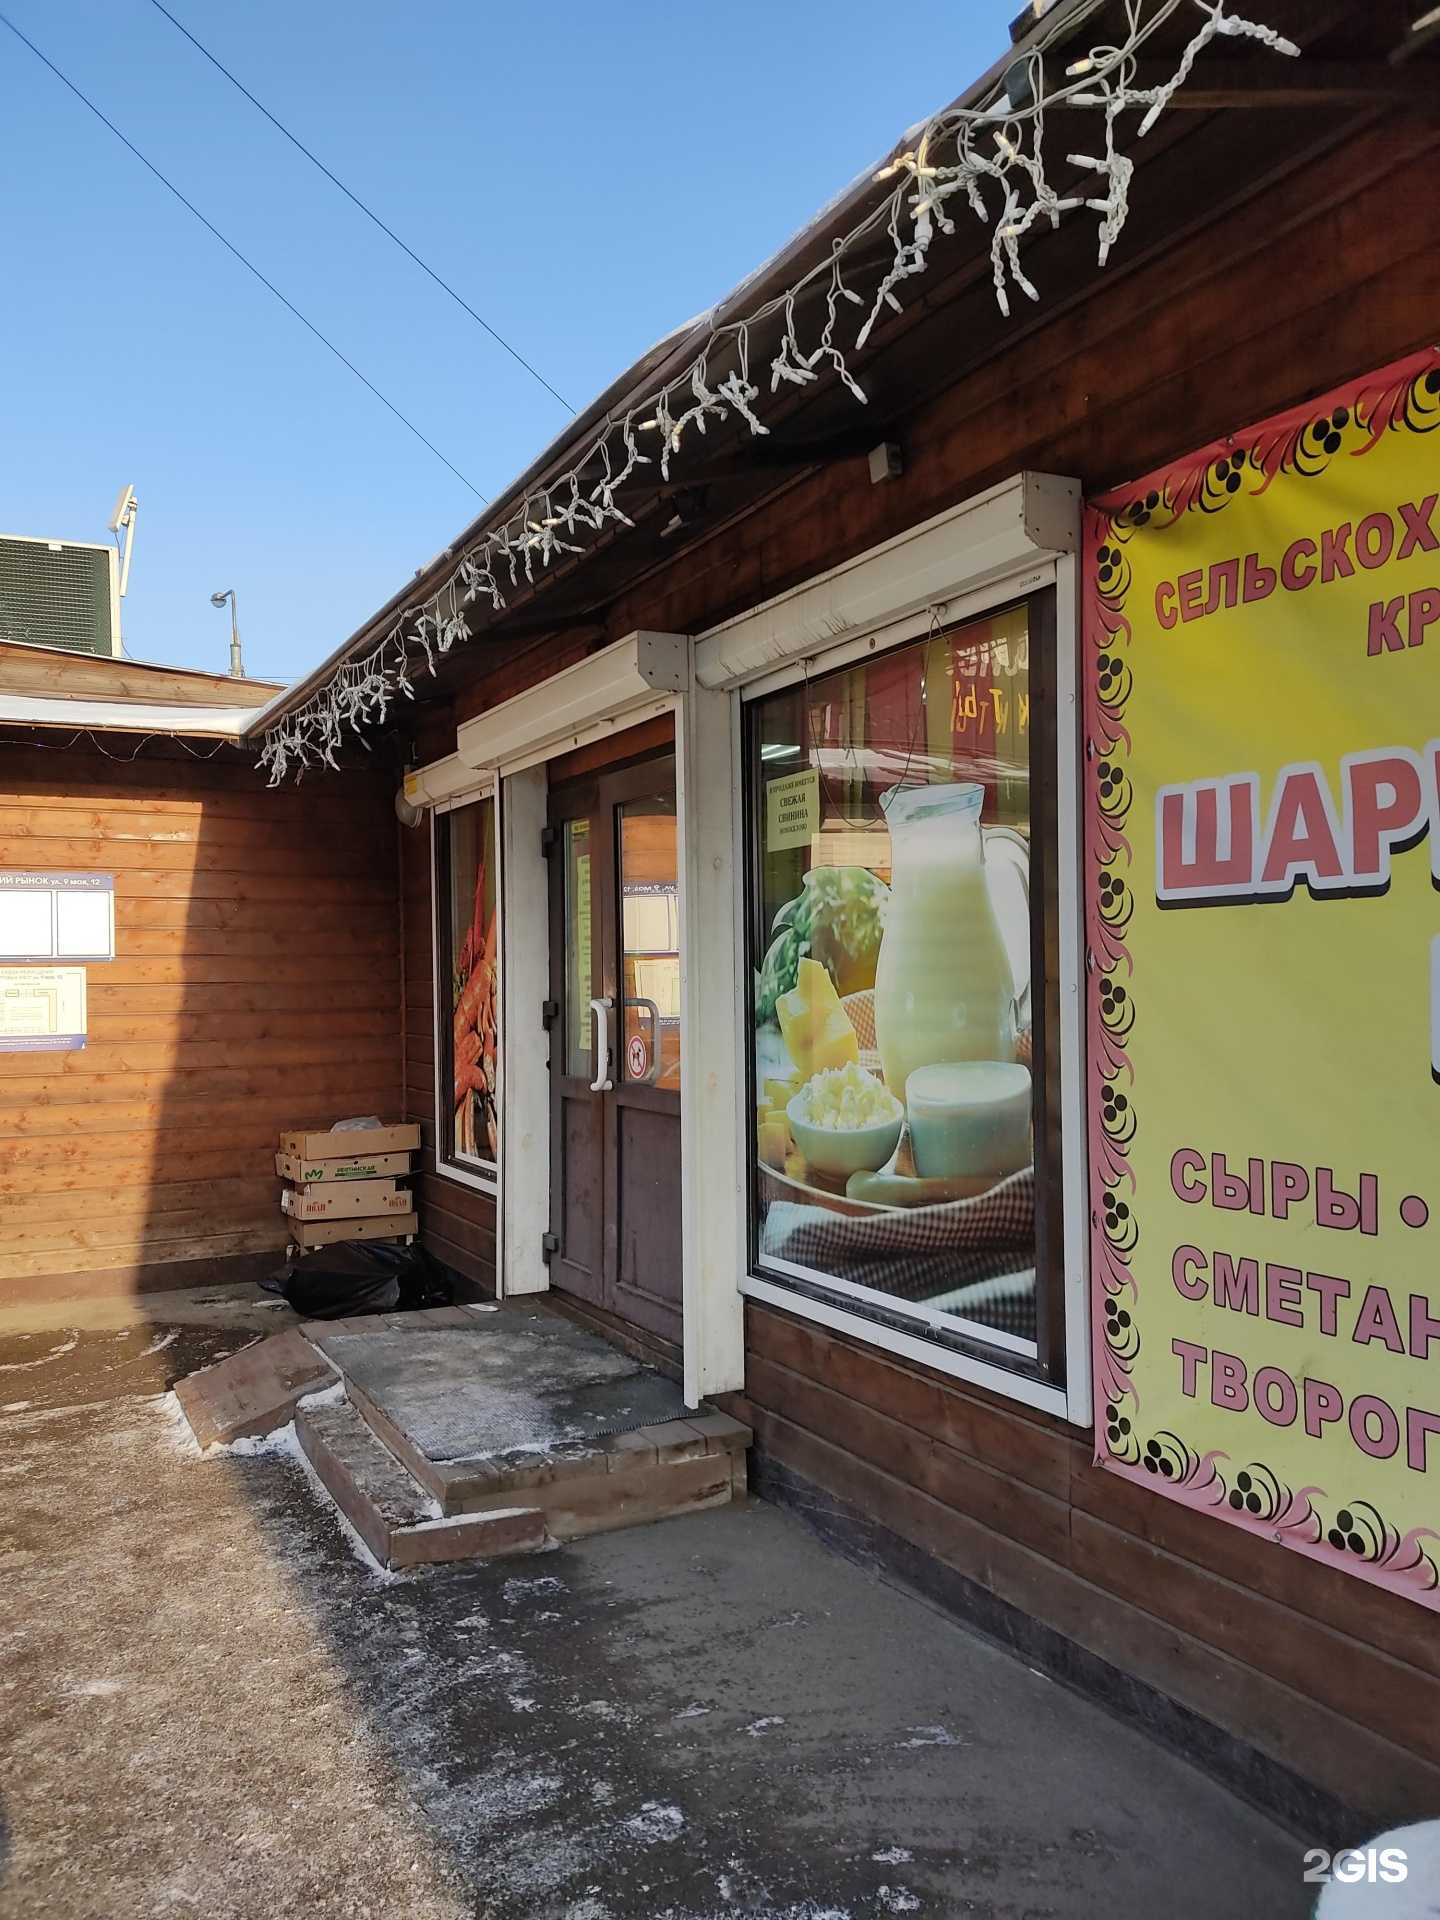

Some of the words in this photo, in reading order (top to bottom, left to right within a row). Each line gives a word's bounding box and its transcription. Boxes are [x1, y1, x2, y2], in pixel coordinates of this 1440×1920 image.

[1154, 493, 1440, 630] СЕЛЬСКОХ
[1366, 586, 1440, 657] КР
[779, 792, 806, 808] СВЕЖАЯ
[1156, 740, 1440, 911] ШАР
[15, 876, 49, 885] РЫНОК
[1170, 1148, 1378, 1236] СЫРЫ
[1171, 1244, 1440, 1360] СМЕТАН
[1171, 1338, 1440, 1474] ТВОРОГ
